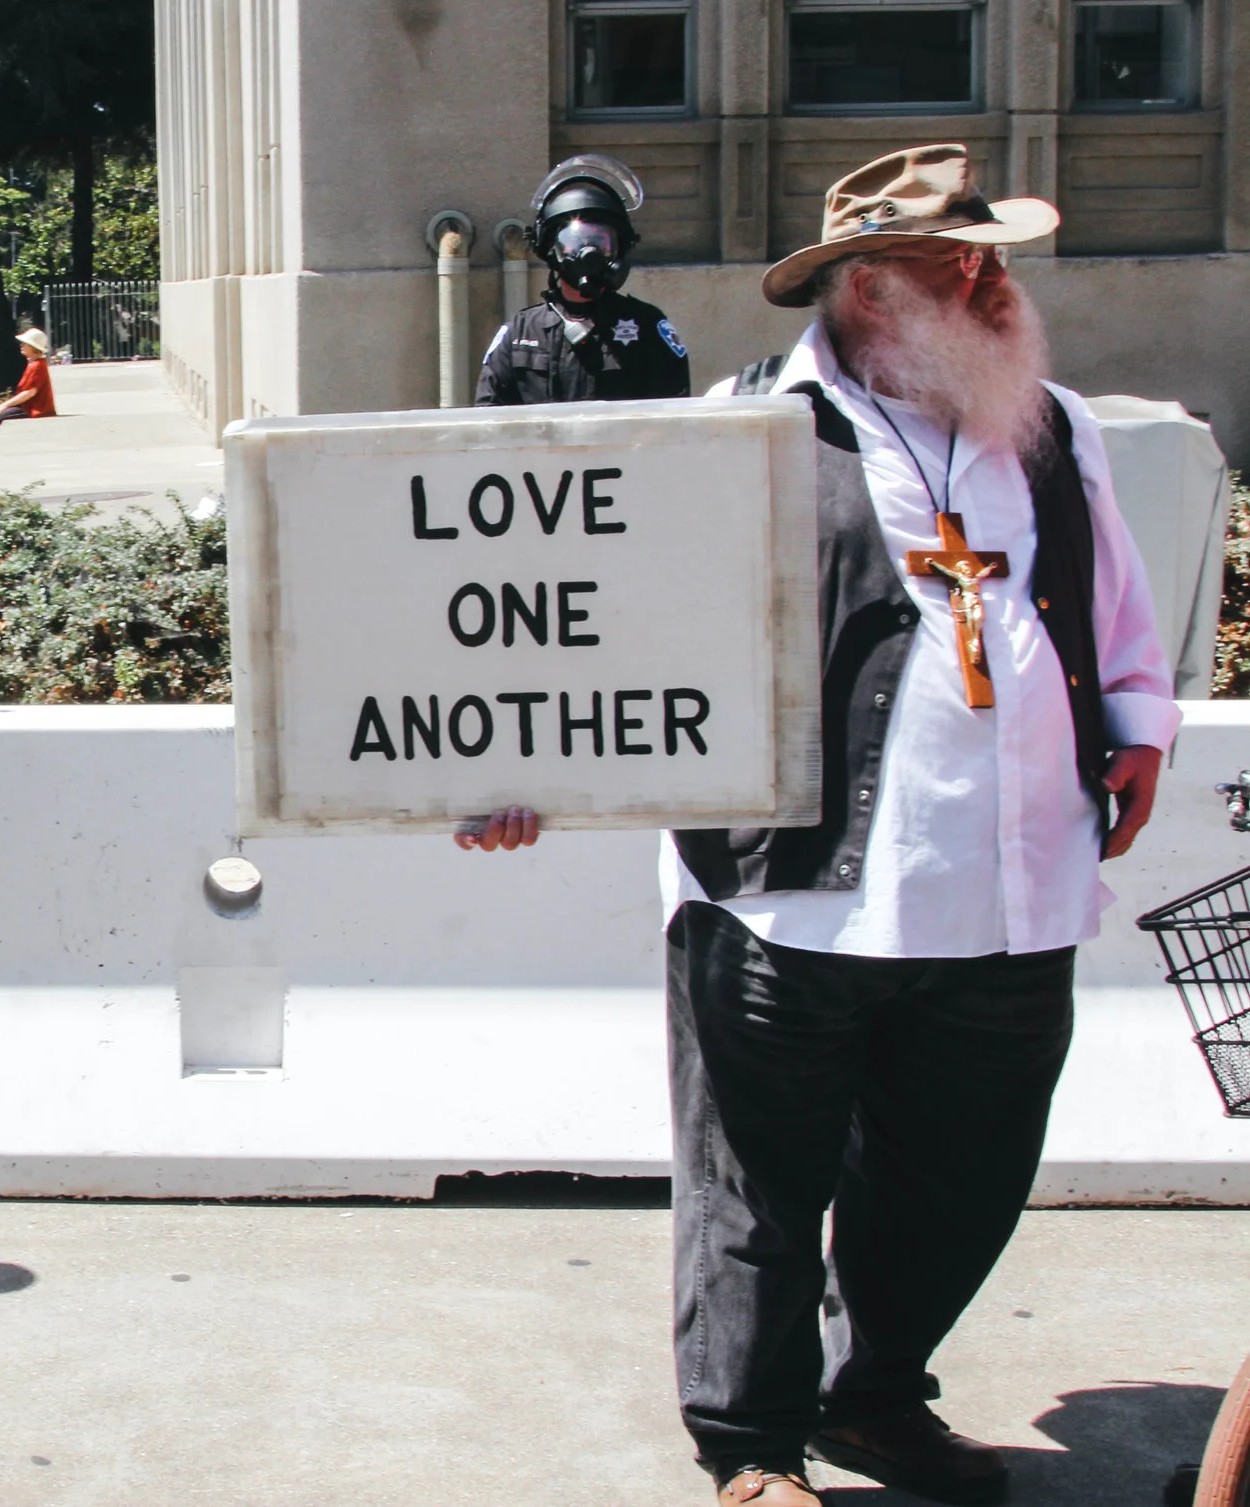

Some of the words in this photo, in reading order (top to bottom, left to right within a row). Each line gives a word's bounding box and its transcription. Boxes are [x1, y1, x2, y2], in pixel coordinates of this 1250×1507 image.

[410, 467, 627, 540] LOVE
[447, 581, 601, 648] ONE
[349, 687, 710, 762] ANOTHER
